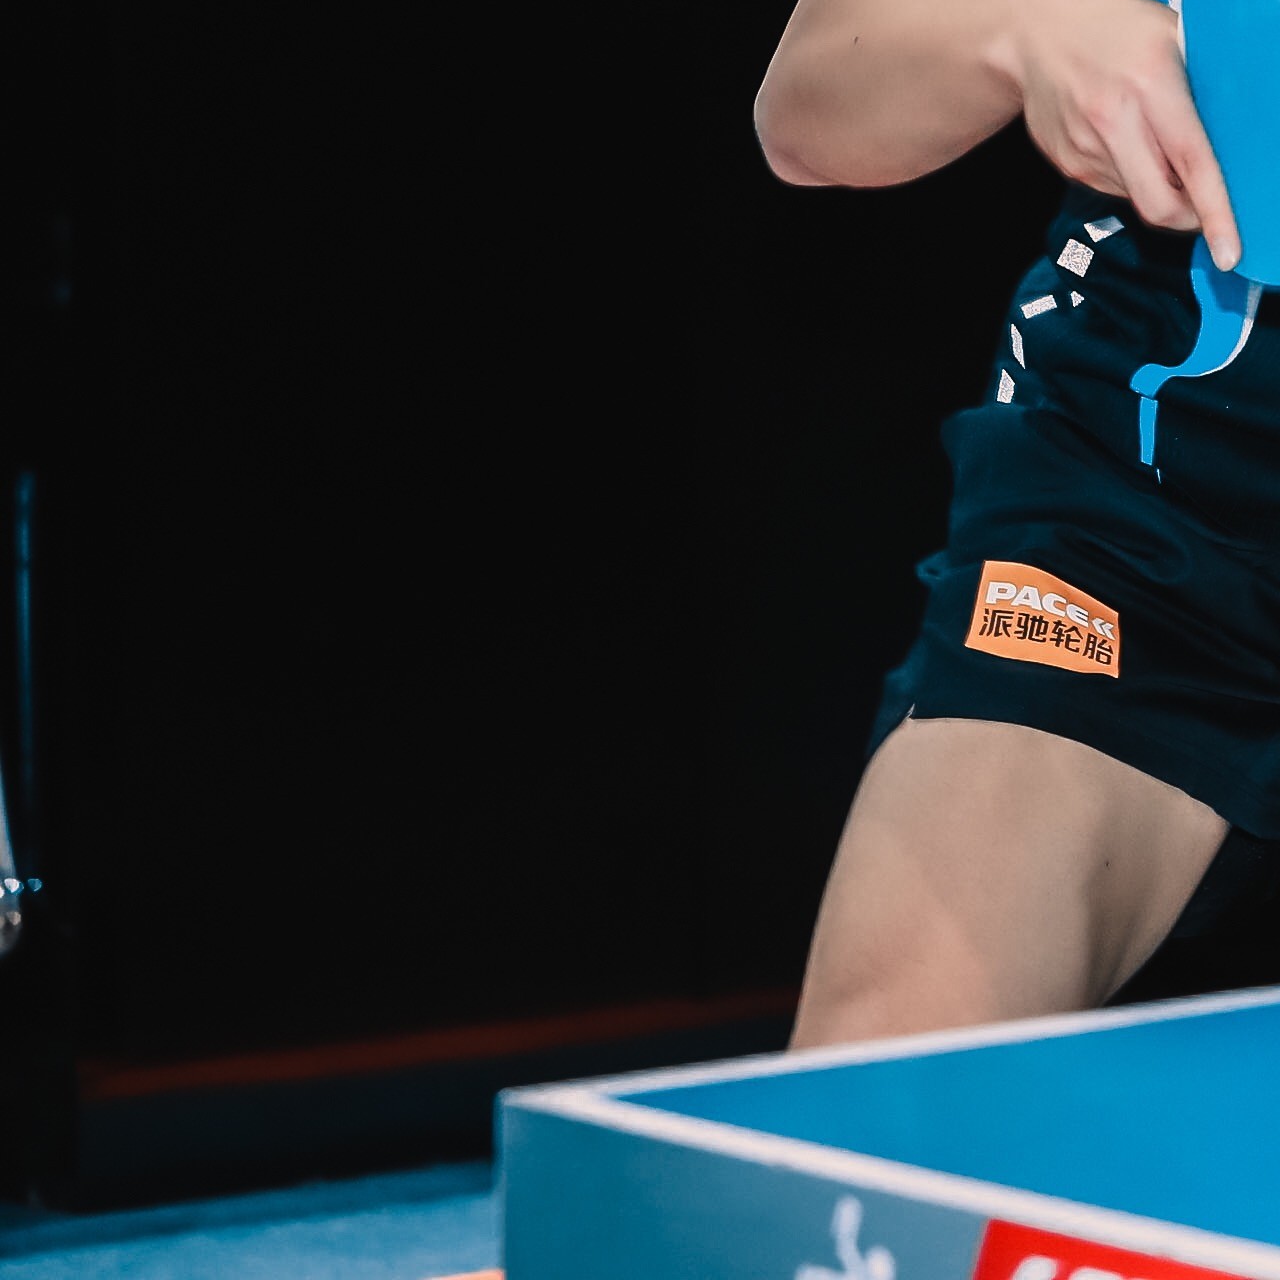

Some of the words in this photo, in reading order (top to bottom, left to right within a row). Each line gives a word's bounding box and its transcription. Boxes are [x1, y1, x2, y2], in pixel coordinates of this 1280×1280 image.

[985, 581, 1089, 628] PACE
[978, 607, 1114, 666] 派驰轮胎
